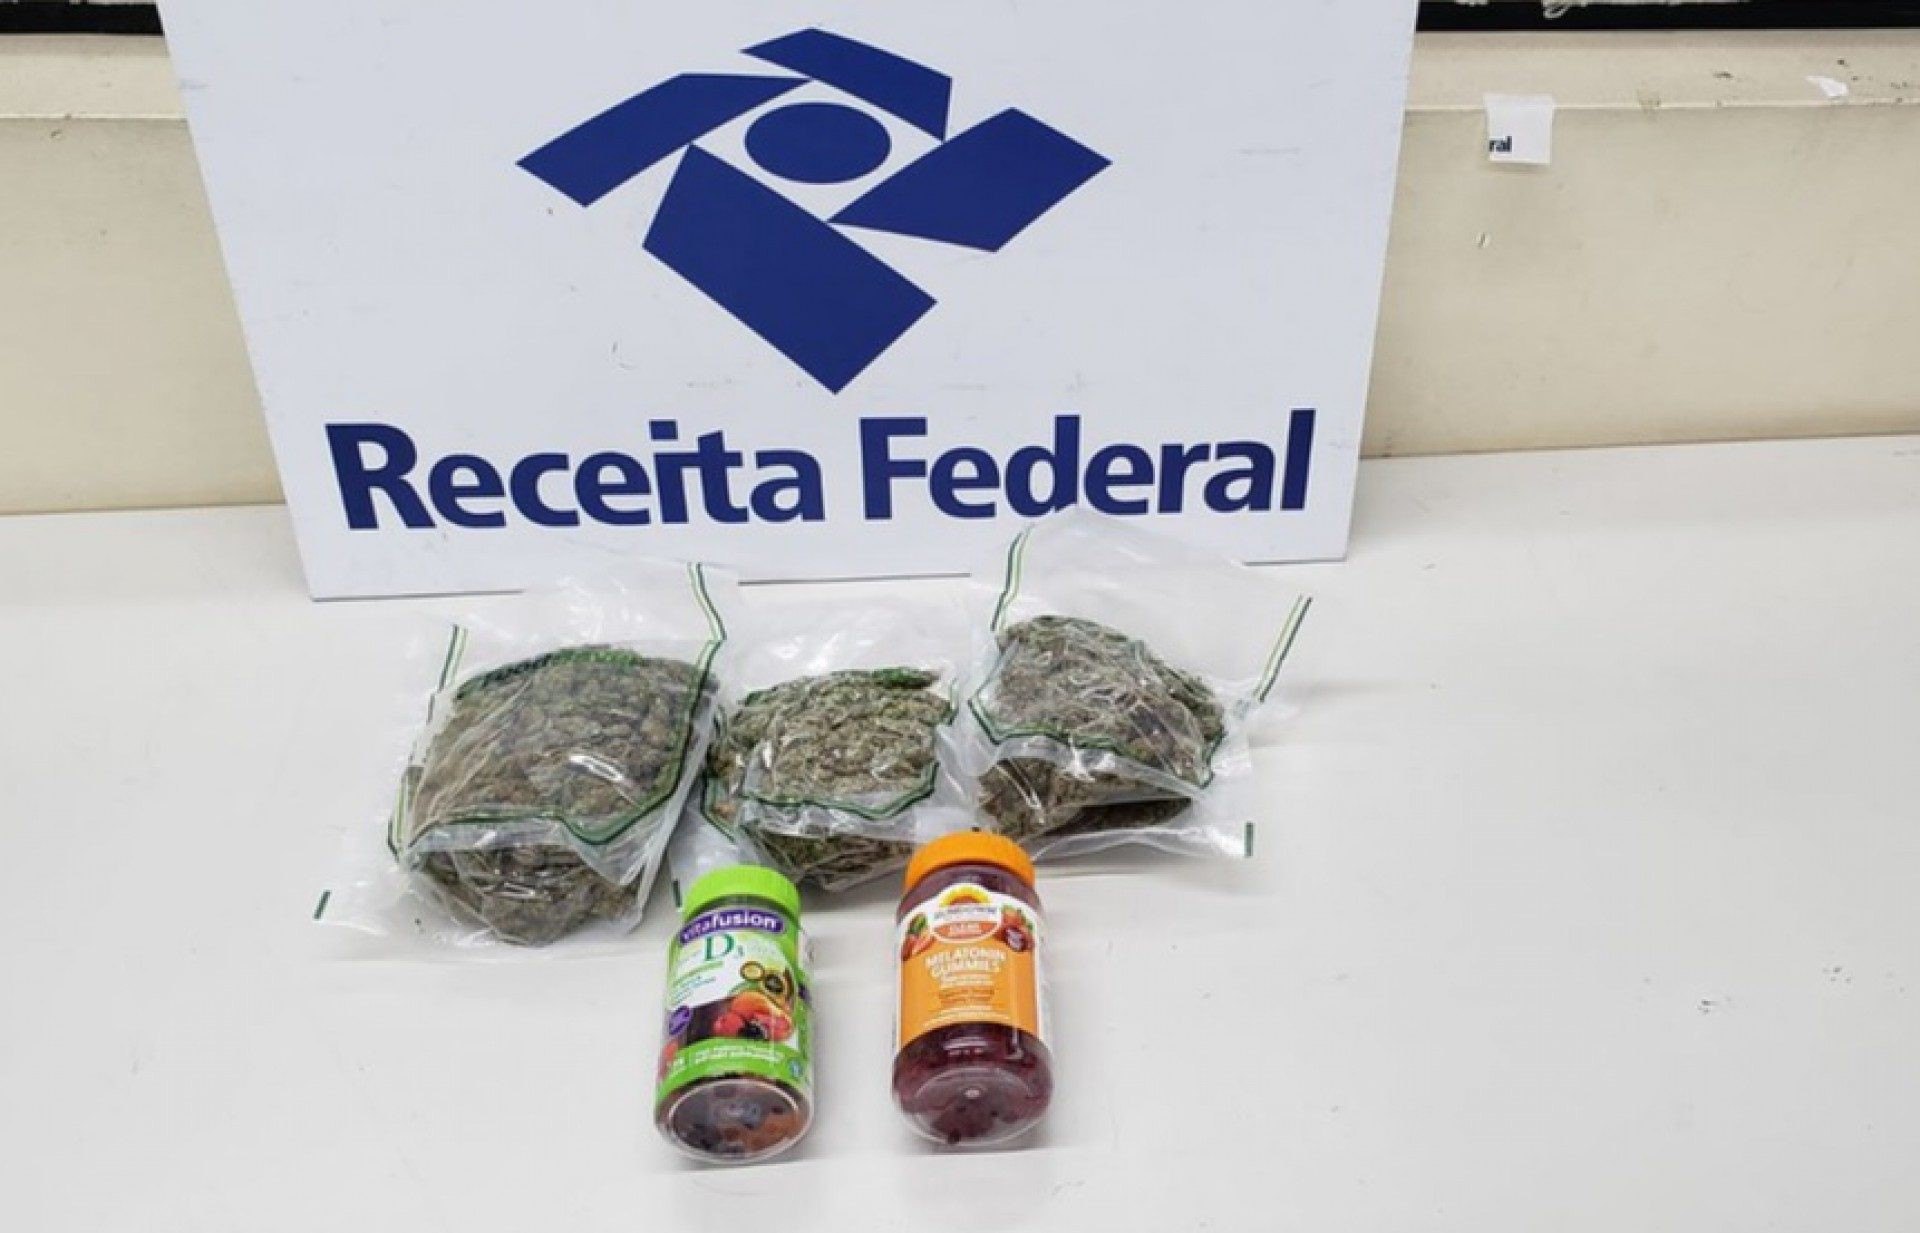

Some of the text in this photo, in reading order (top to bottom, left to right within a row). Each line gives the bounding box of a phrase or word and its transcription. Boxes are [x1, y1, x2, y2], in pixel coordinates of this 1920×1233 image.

[326, 409, 1315, 530] Receita Federal
[681, 909, 777, 941] vitafusion
